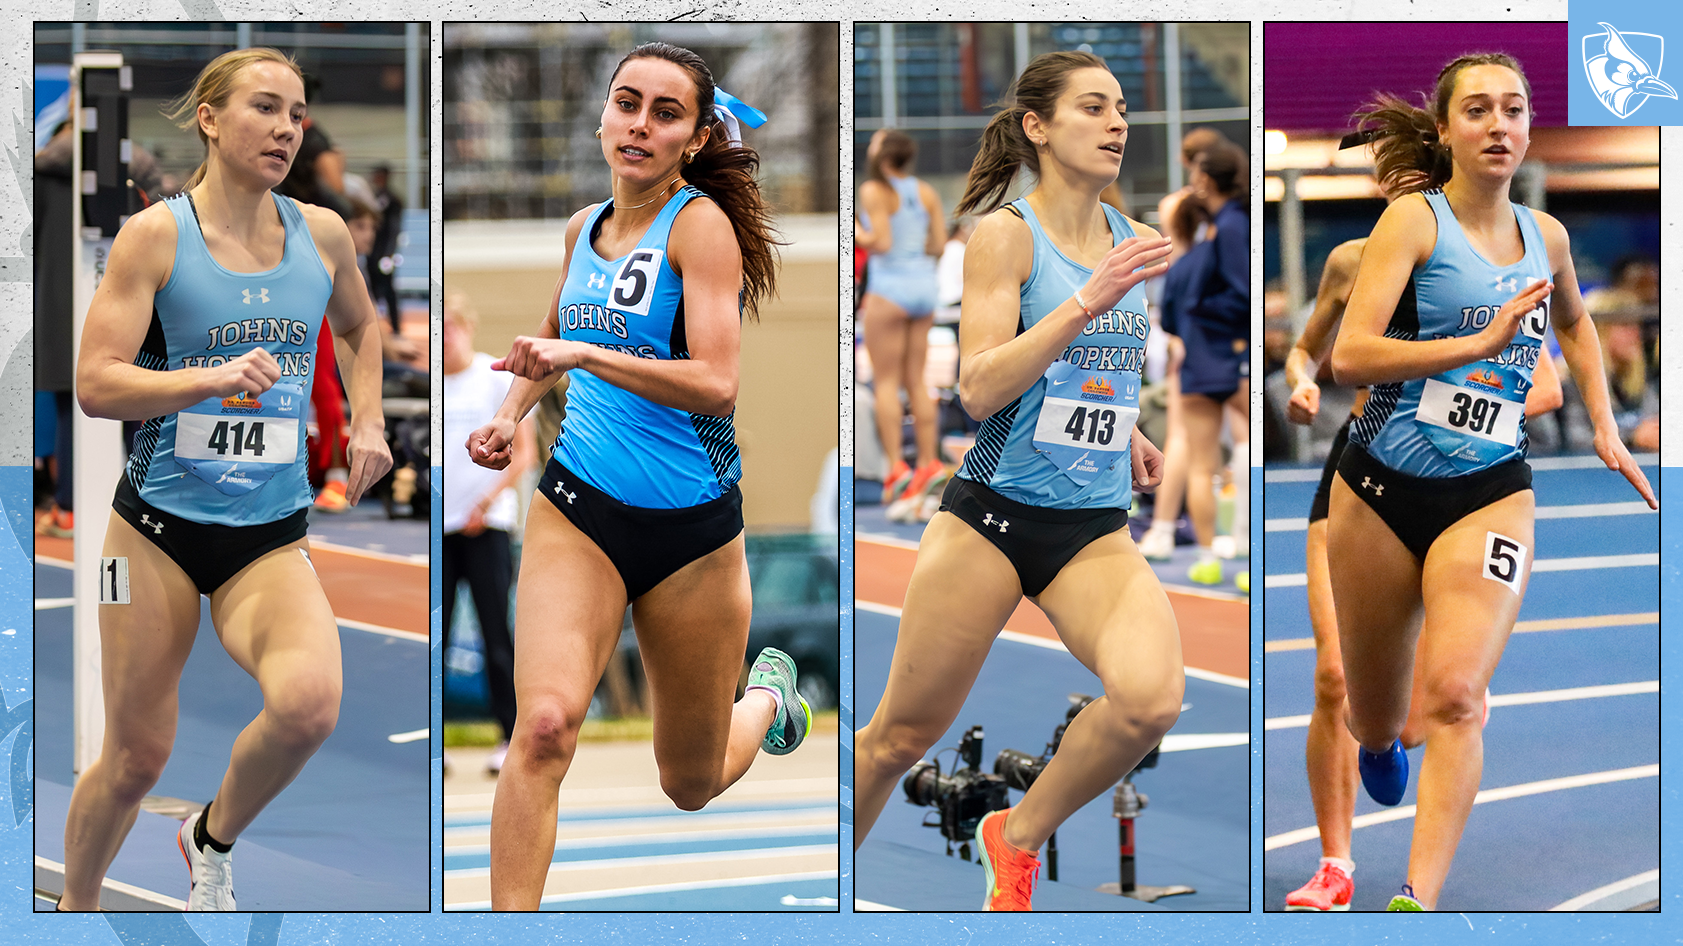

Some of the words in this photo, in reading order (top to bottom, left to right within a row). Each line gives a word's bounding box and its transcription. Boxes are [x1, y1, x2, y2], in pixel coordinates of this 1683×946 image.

[614, 252, 653, 307] 5
[206, 318, 308, 350] JOHNS
[561, 303, 628, 339] JOHNS
[1081, 308, 1147, 341] OHNS
[1064, 406, 1117, 445] 413
[1448, 392, 1502, 435] 397
[208, 421, 265, 456] 414
[1084, 459, 1095, 467] THE
[1489, 537, 1519, 583] 5
